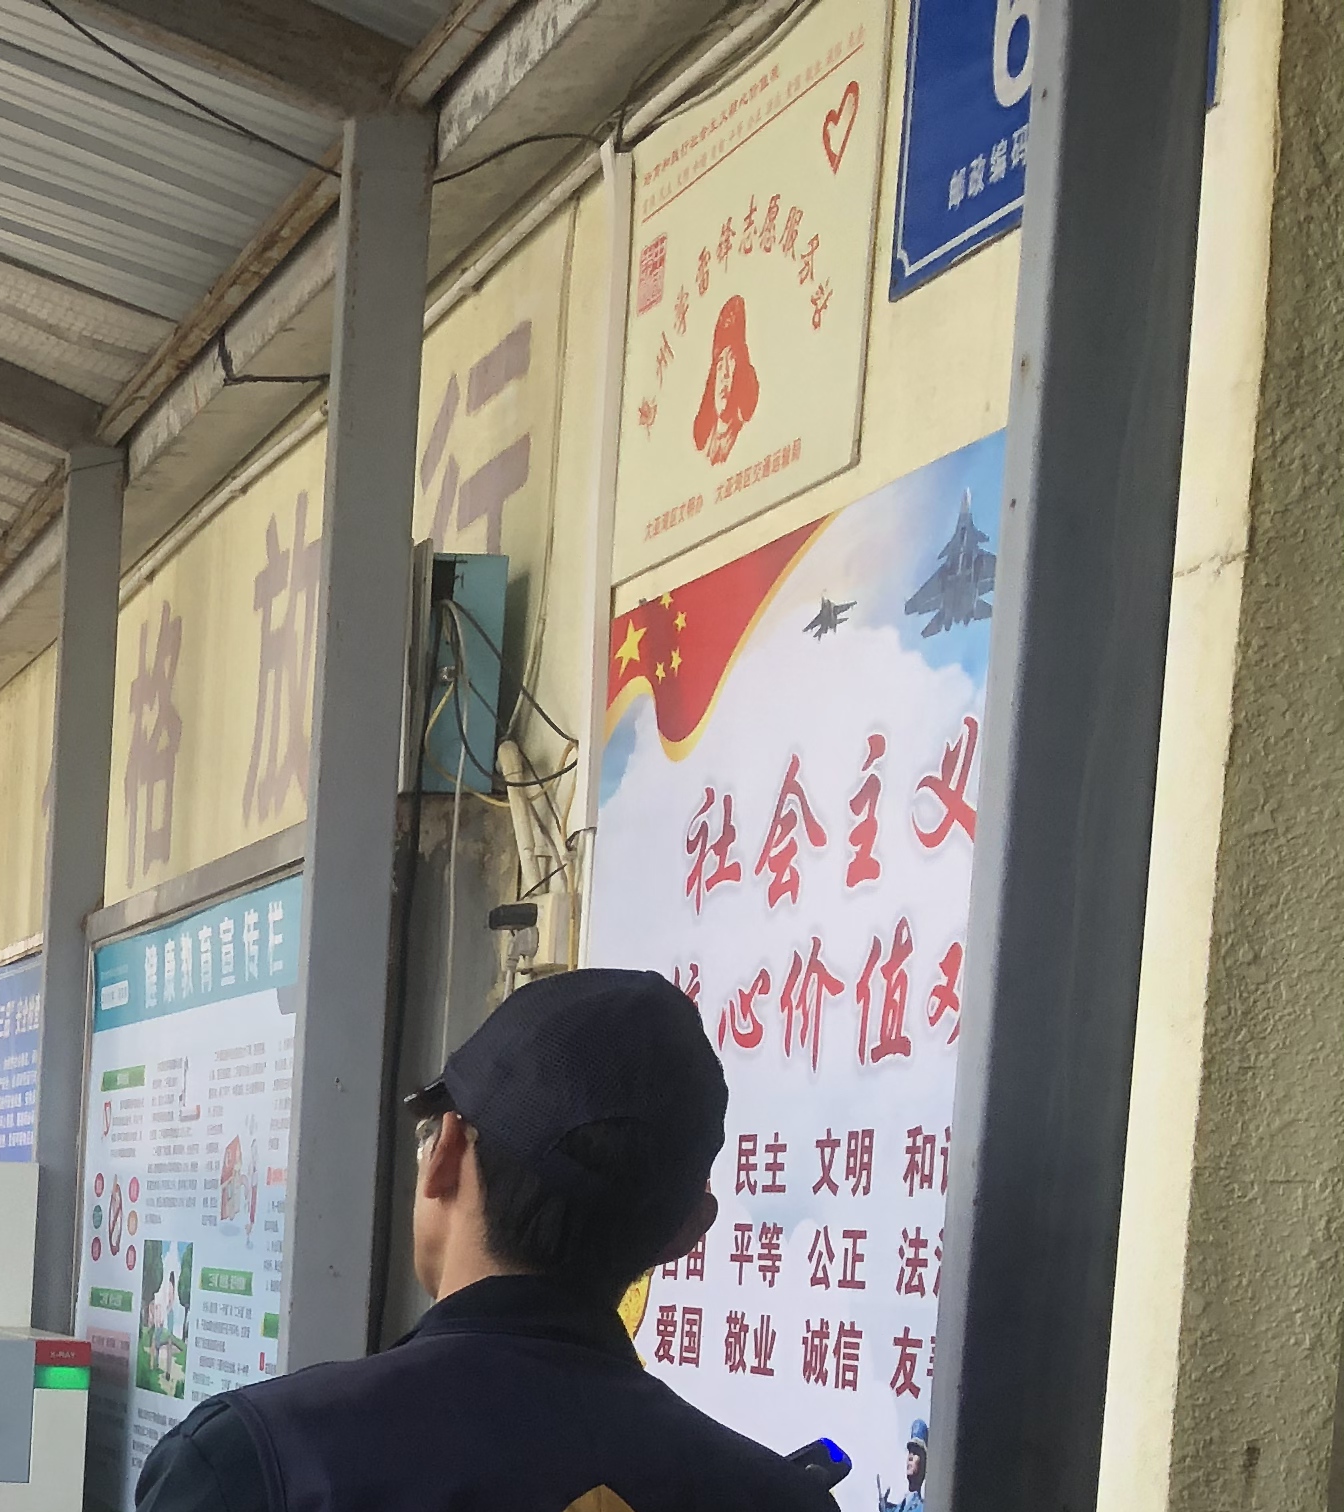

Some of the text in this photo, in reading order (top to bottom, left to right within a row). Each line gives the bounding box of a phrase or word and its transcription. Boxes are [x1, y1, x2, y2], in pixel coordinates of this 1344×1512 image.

[686, 716, 978, 915] 社会主义
[735, 1132, 787, 1196] 民主
[812, 1128, 875, 1197] 文明
[730, 1222, 784, 1288] 平等
[808, 1225, 867, 1290] 公正
[50, 1350, 76, 1360] X-RAY
[654, 1304, 703, 1368] 爱国
[724, 1310, 777, 1377] 敬业
[801, 1318, 863, 1391] 诚信
